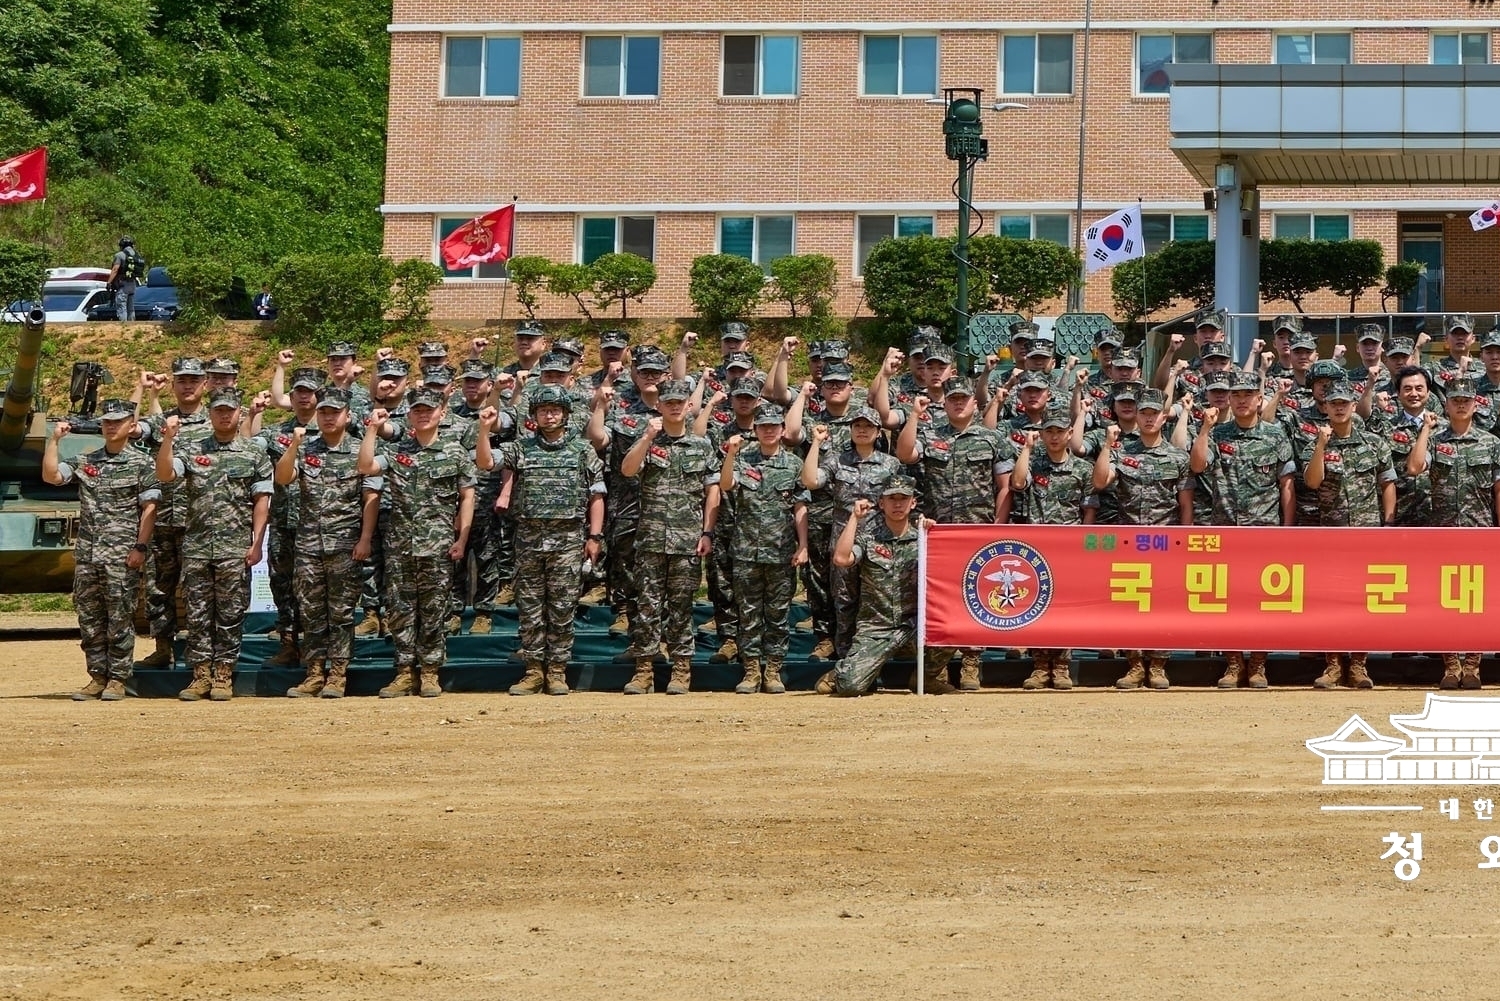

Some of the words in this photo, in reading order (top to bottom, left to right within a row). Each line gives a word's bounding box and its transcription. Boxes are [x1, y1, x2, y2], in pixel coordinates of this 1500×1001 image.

[1136, 534, 1168, 551] 명예
[1188, 534, 1221, 552] 도전
[1110, 563, 1304, 613] 국민의
[984, 614, 1023, 626] MARINE
[1024, 593, 1047, 620] CORPS
